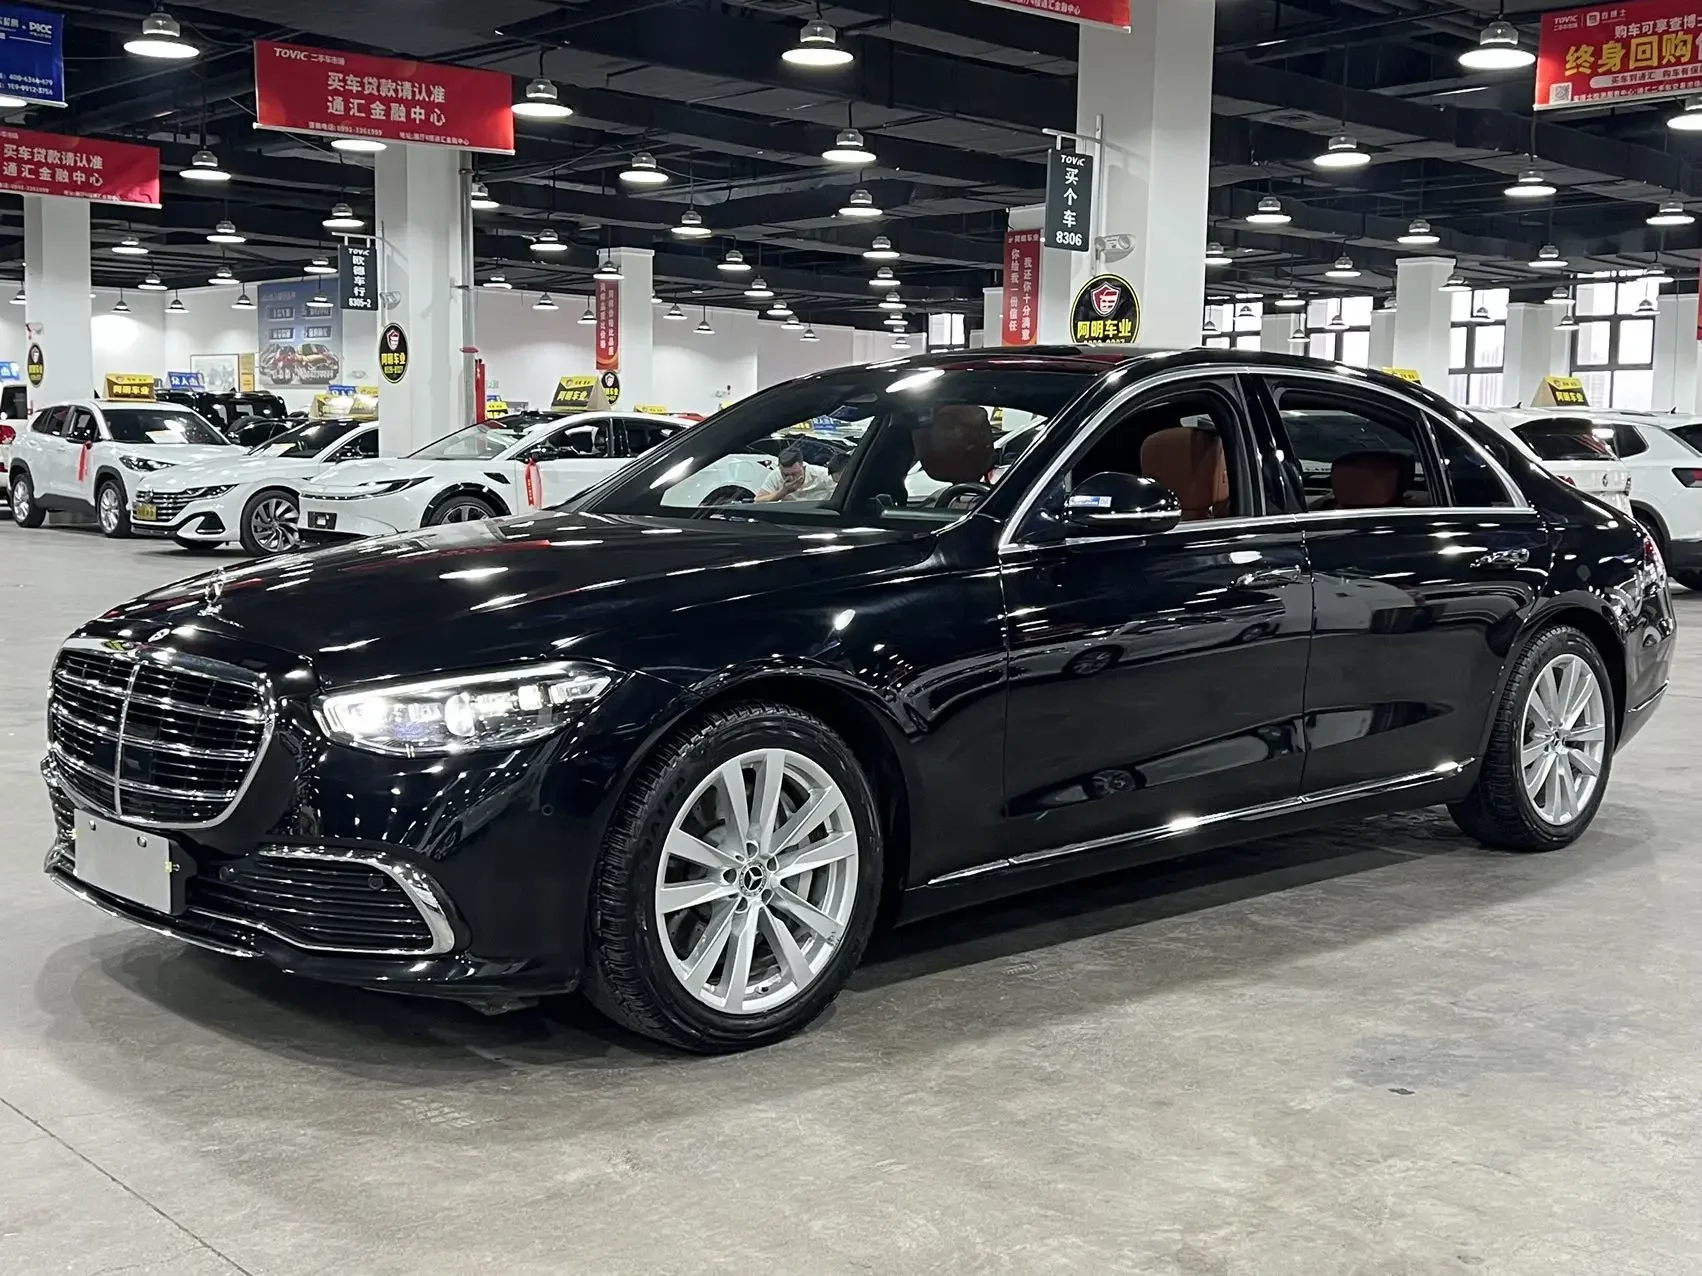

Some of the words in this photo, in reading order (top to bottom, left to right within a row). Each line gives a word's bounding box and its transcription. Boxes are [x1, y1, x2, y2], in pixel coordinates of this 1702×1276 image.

[274, 47, 308, 60] TOVIC
[1564, 31, 1702, 77] 终身回购
[327, 71, 446, 104] 买车贷款请认准
[327, 95, 446, 127] 通汇金融中心
[3, 143, 104, 169] 买车贷款请认准
[1060, 154, 1086, 167] TOVIC
[2, 161, 104, 187] 通汇金融中心
[1062, 167, 1079, 228] 买个车
[1055, 230, 1083, 246] 8306
[348, 248, 370, 256] TOVIC
[1008, 248, 1020, 331] 你给我一份信任
[1021, 257, 1033, 341] 我还你十分满意
[1077, 319, 1132, 339] 阿明车业
[113, 385, 149, 394] 阿明车业
